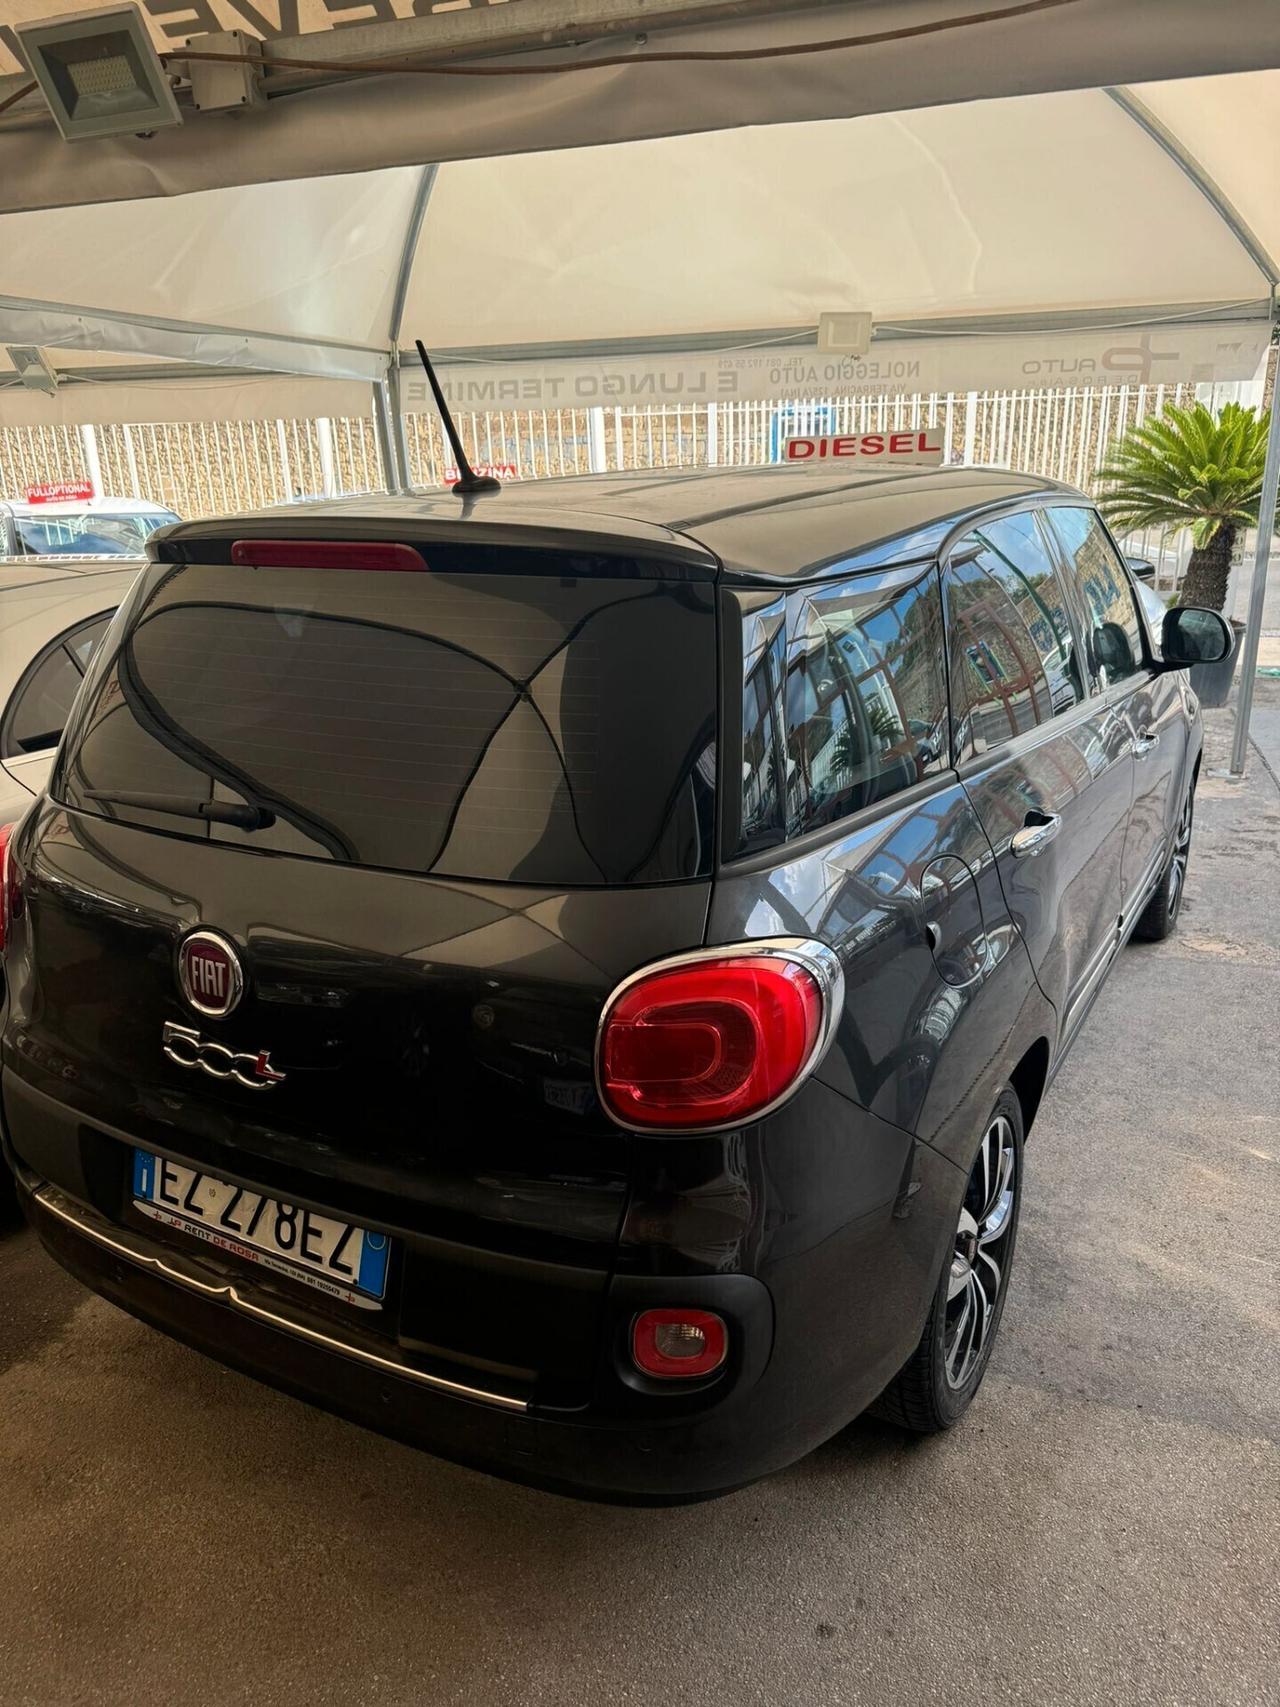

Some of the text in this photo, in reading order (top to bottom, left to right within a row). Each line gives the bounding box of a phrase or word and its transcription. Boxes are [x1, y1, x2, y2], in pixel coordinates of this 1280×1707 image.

[788, 433, 941, 459] DIESEL
[445, 467, 515, 480] BZINA
[28, 484, 90, 497] FULLOPTIONAL
[191, 955, 226, 998] FIAT
[162, 1020, 287, 1090] 500L
[184, 1224, 212, 1240] RENT
[213, 1235, 228, 1248] DE
[229, 1244, 260, 1262] ROSA
